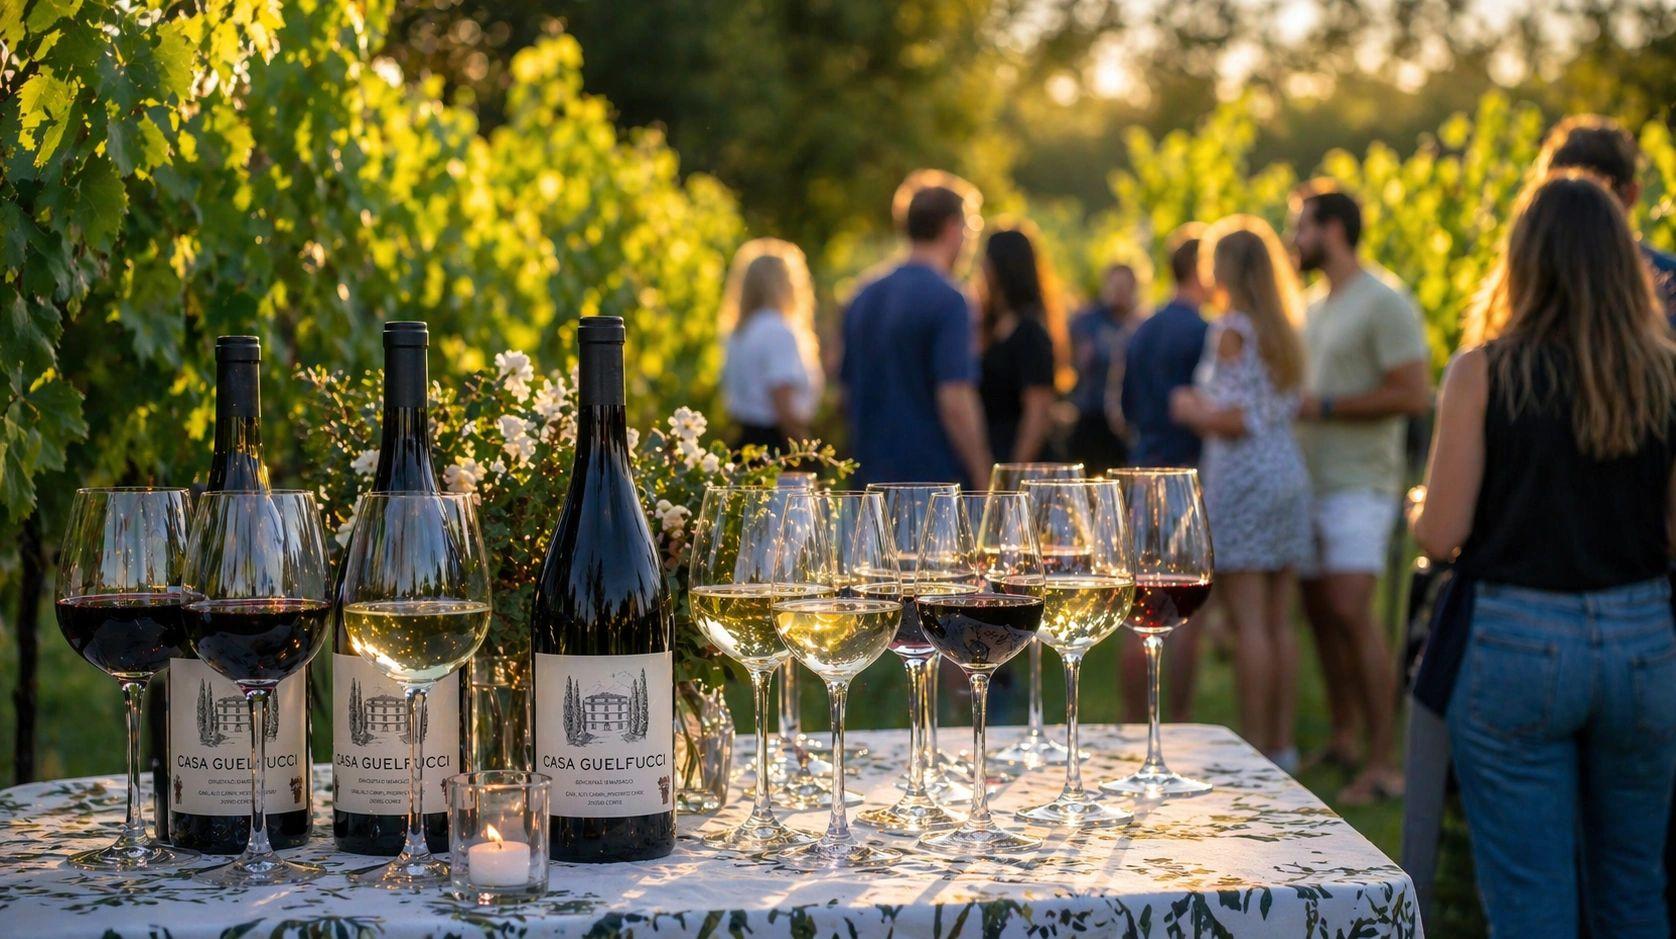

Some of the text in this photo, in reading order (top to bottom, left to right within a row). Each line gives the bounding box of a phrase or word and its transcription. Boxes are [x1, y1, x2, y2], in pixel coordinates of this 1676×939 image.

[177, 754, 208, 770] CASA
[543, 753, 666, 771] CASA GUELFUCCI
